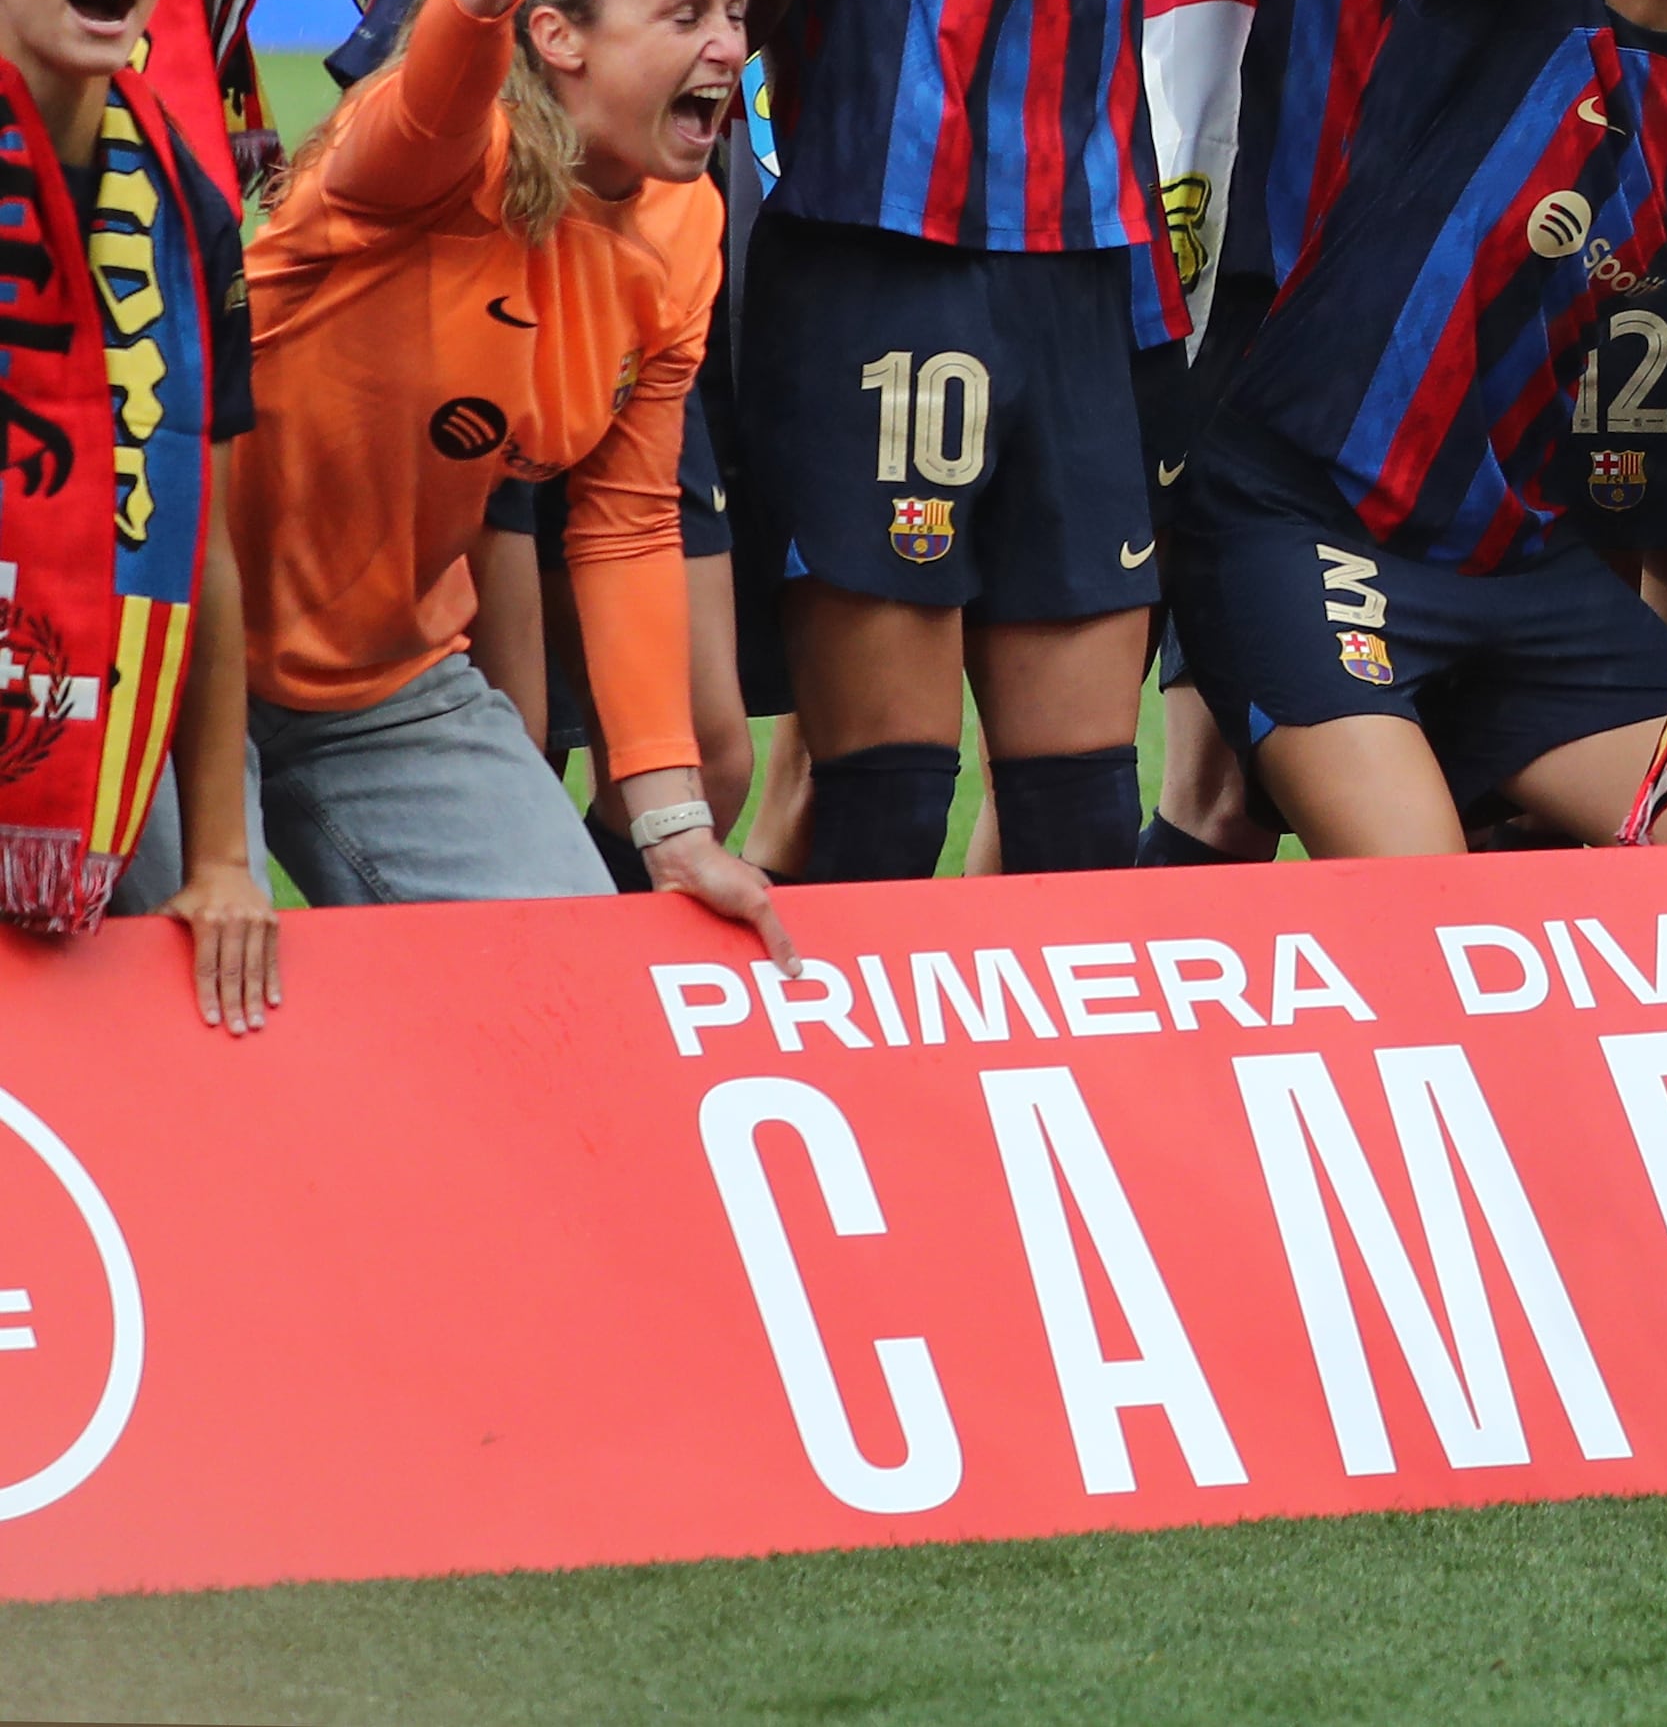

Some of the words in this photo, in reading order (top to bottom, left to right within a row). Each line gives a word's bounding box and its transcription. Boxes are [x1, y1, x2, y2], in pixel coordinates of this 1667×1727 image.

[861, 350, 990, 486] 10
[908, 525, 934, 534] FCB
[650, 933, 1375, 1056] PRIMERA
